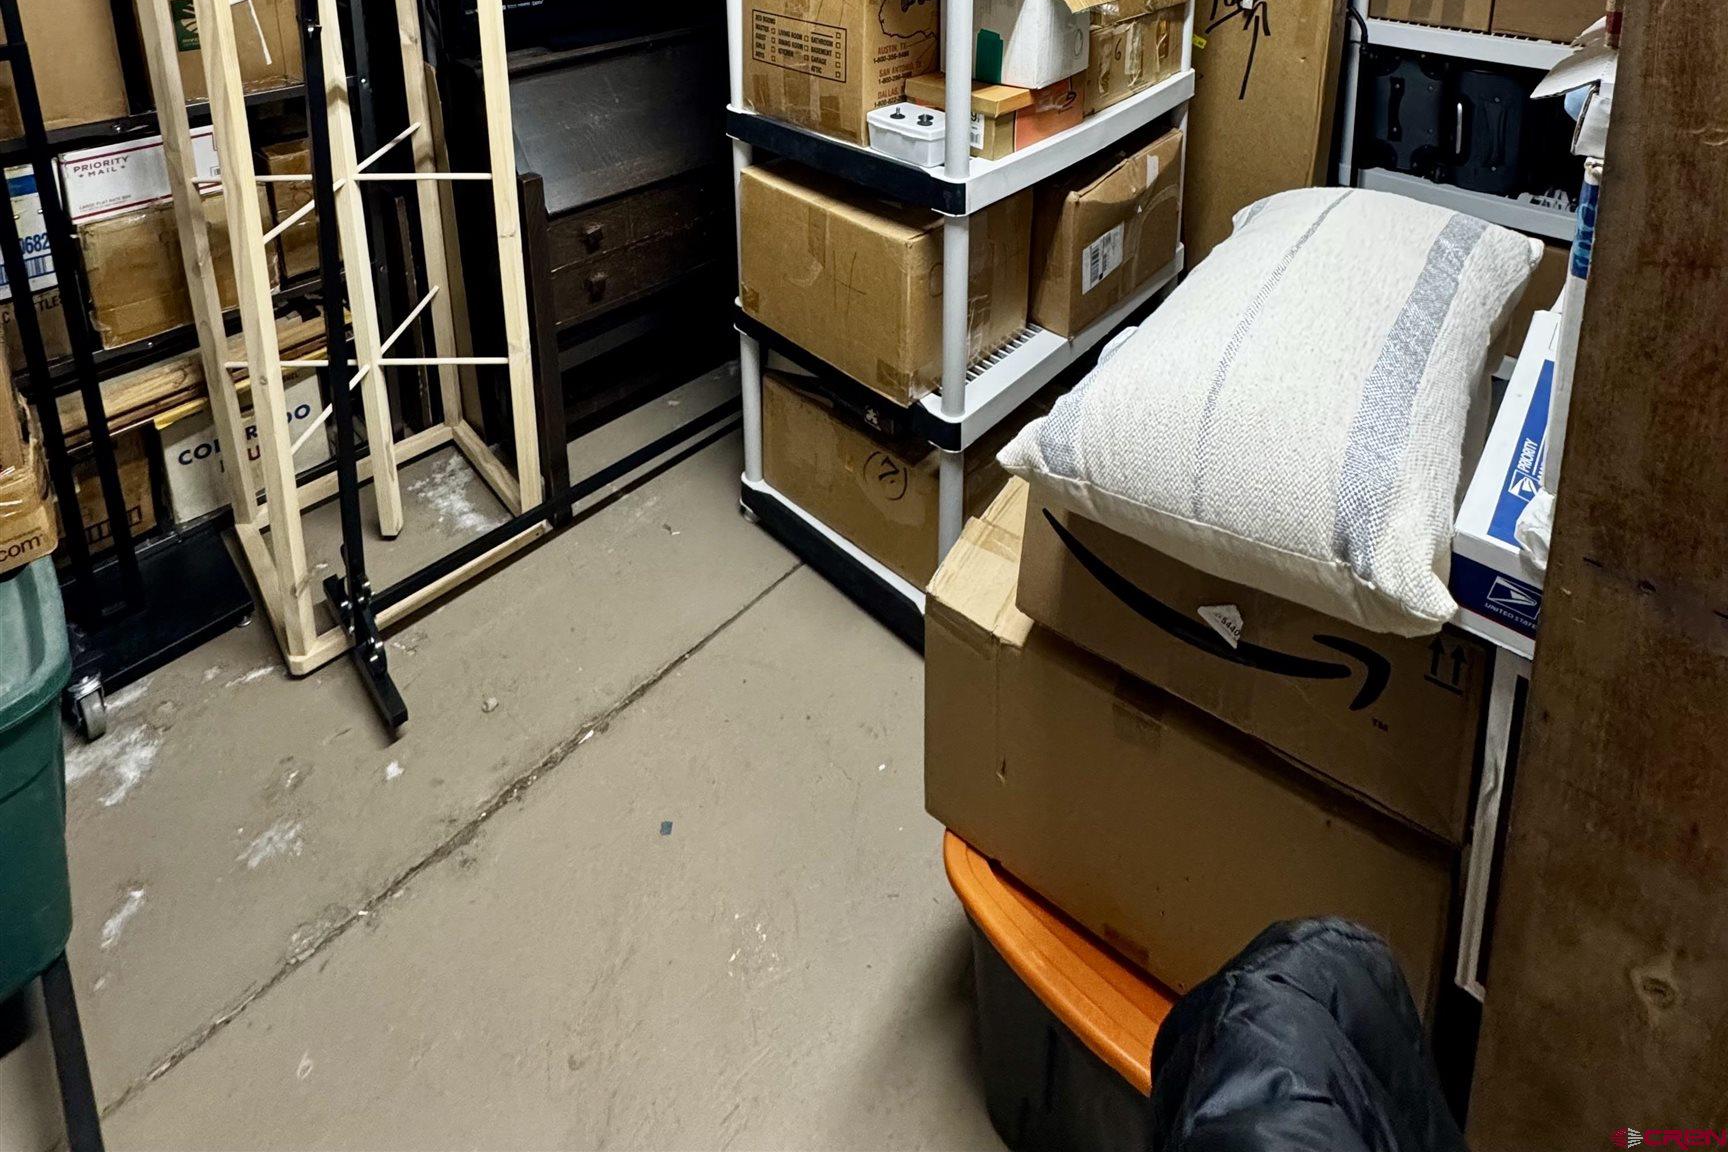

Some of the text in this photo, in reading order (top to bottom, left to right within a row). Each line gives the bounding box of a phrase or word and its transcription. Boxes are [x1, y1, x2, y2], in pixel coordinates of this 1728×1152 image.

[879, 67, 890, 77] SAN
[73, 155, 129, 173] PRIORITY
[88, 166, 117, 177] MAIL
[1516, 437, 1538, 473] PRIORITY
[1484, 602, 1514, 620] UNITED
[1221, 617, 1241, 637] 5440
